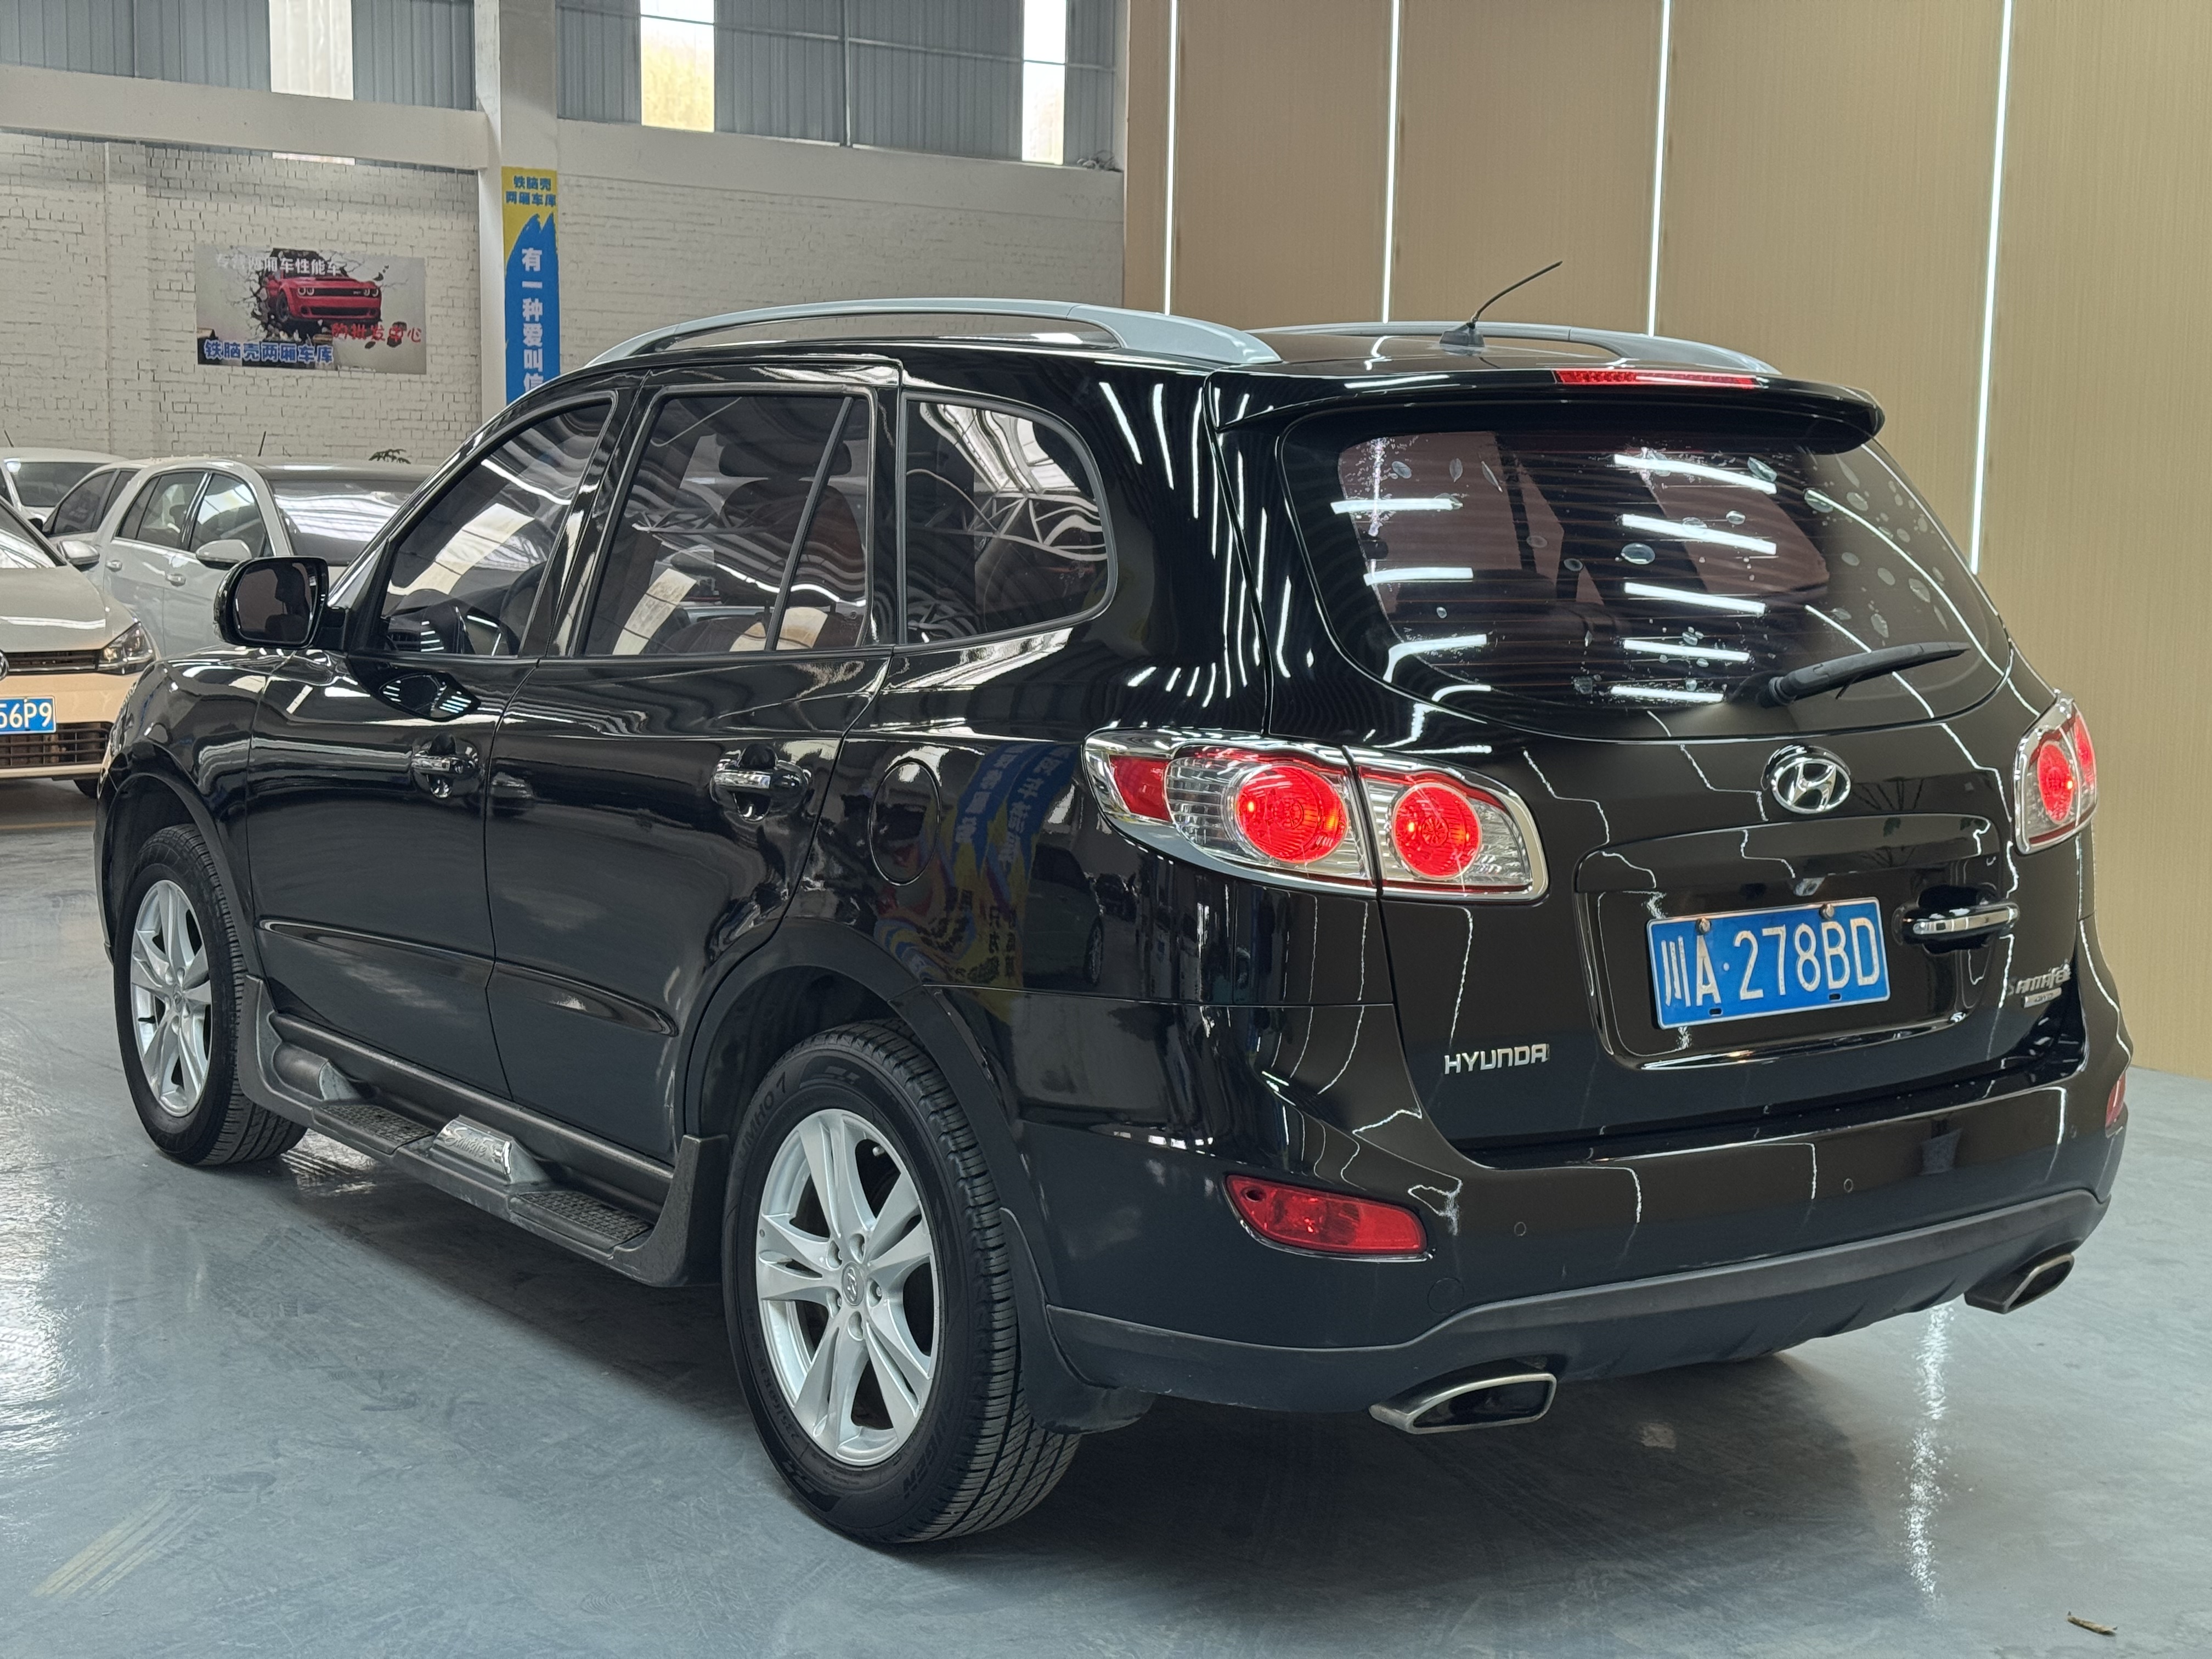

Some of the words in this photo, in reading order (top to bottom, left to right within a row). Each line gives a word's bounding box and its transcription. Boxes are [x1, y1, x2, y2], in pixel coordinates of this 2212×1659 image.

[331, 323, 421, 342] 的批发中心
[204, 339, 334, 364] 铁脑壳两厢车库
